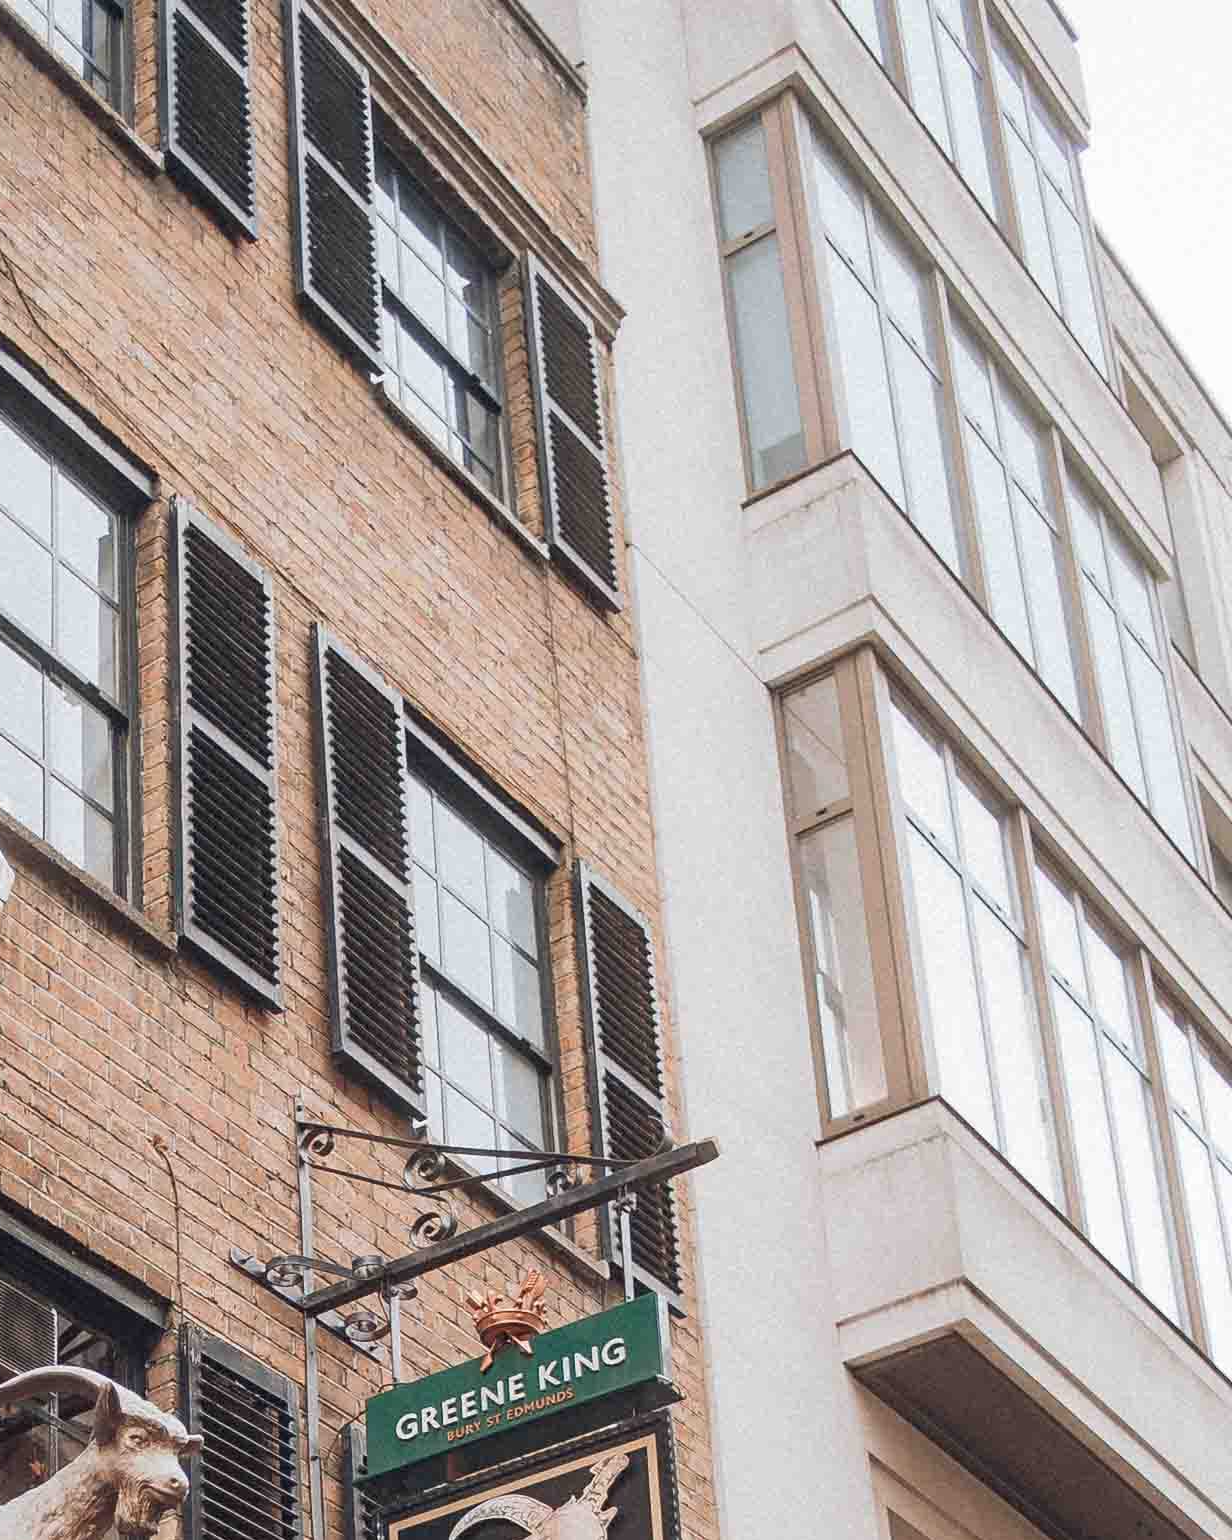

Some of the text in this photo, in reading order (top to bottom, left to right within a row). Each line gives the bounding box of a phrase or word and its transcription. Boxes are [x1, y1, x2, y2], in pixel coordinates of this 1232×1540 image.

[395, 1337, 627, 1440] GREENE KING
[447, 1388, 575, 1442] BURY ST EDMUNDS
